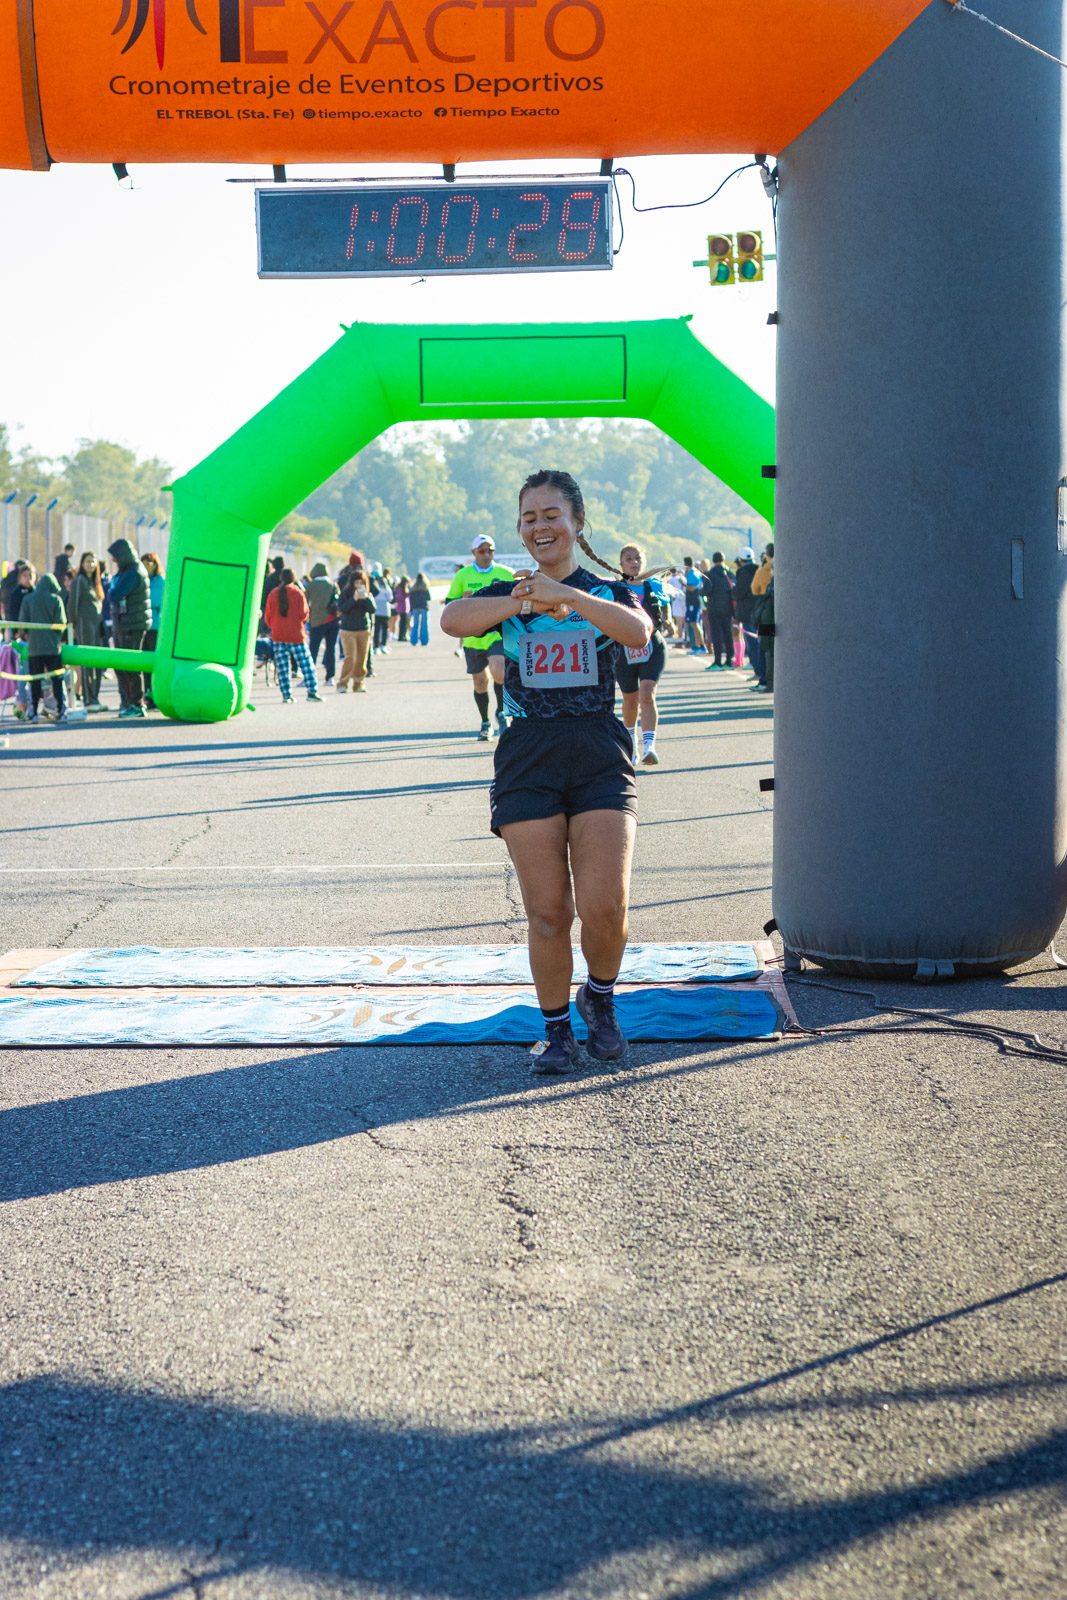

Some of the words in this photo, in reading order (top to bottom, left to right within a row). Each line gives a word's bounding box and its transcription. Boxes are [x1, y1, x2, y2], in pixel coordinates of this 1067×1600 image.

[244, 0, 605, 64] EXACTO
[109, 75, 291, 99] Cronometraje
[298, 74, 332, 94] de
[340, 74, 446, 94] Eventos
[454, 72, 604, 97] Deportivos
[156, 109, 175, 119] EL
[175, 109, 234, 119] TREBOL
[237, 108, 270, 120] (Sta.
[273, 108, 295, 120] Fe)
[318, 108, 423, 120] tiempo.exacto
[450, 107, 507, 119] Tiempo
[510, 106, 560, 117] Exacto
[346, 191, 600, 264] 1:00:28
[533, 643, 582, 674] 221
[581, 639, 590, 674] EXACTO
